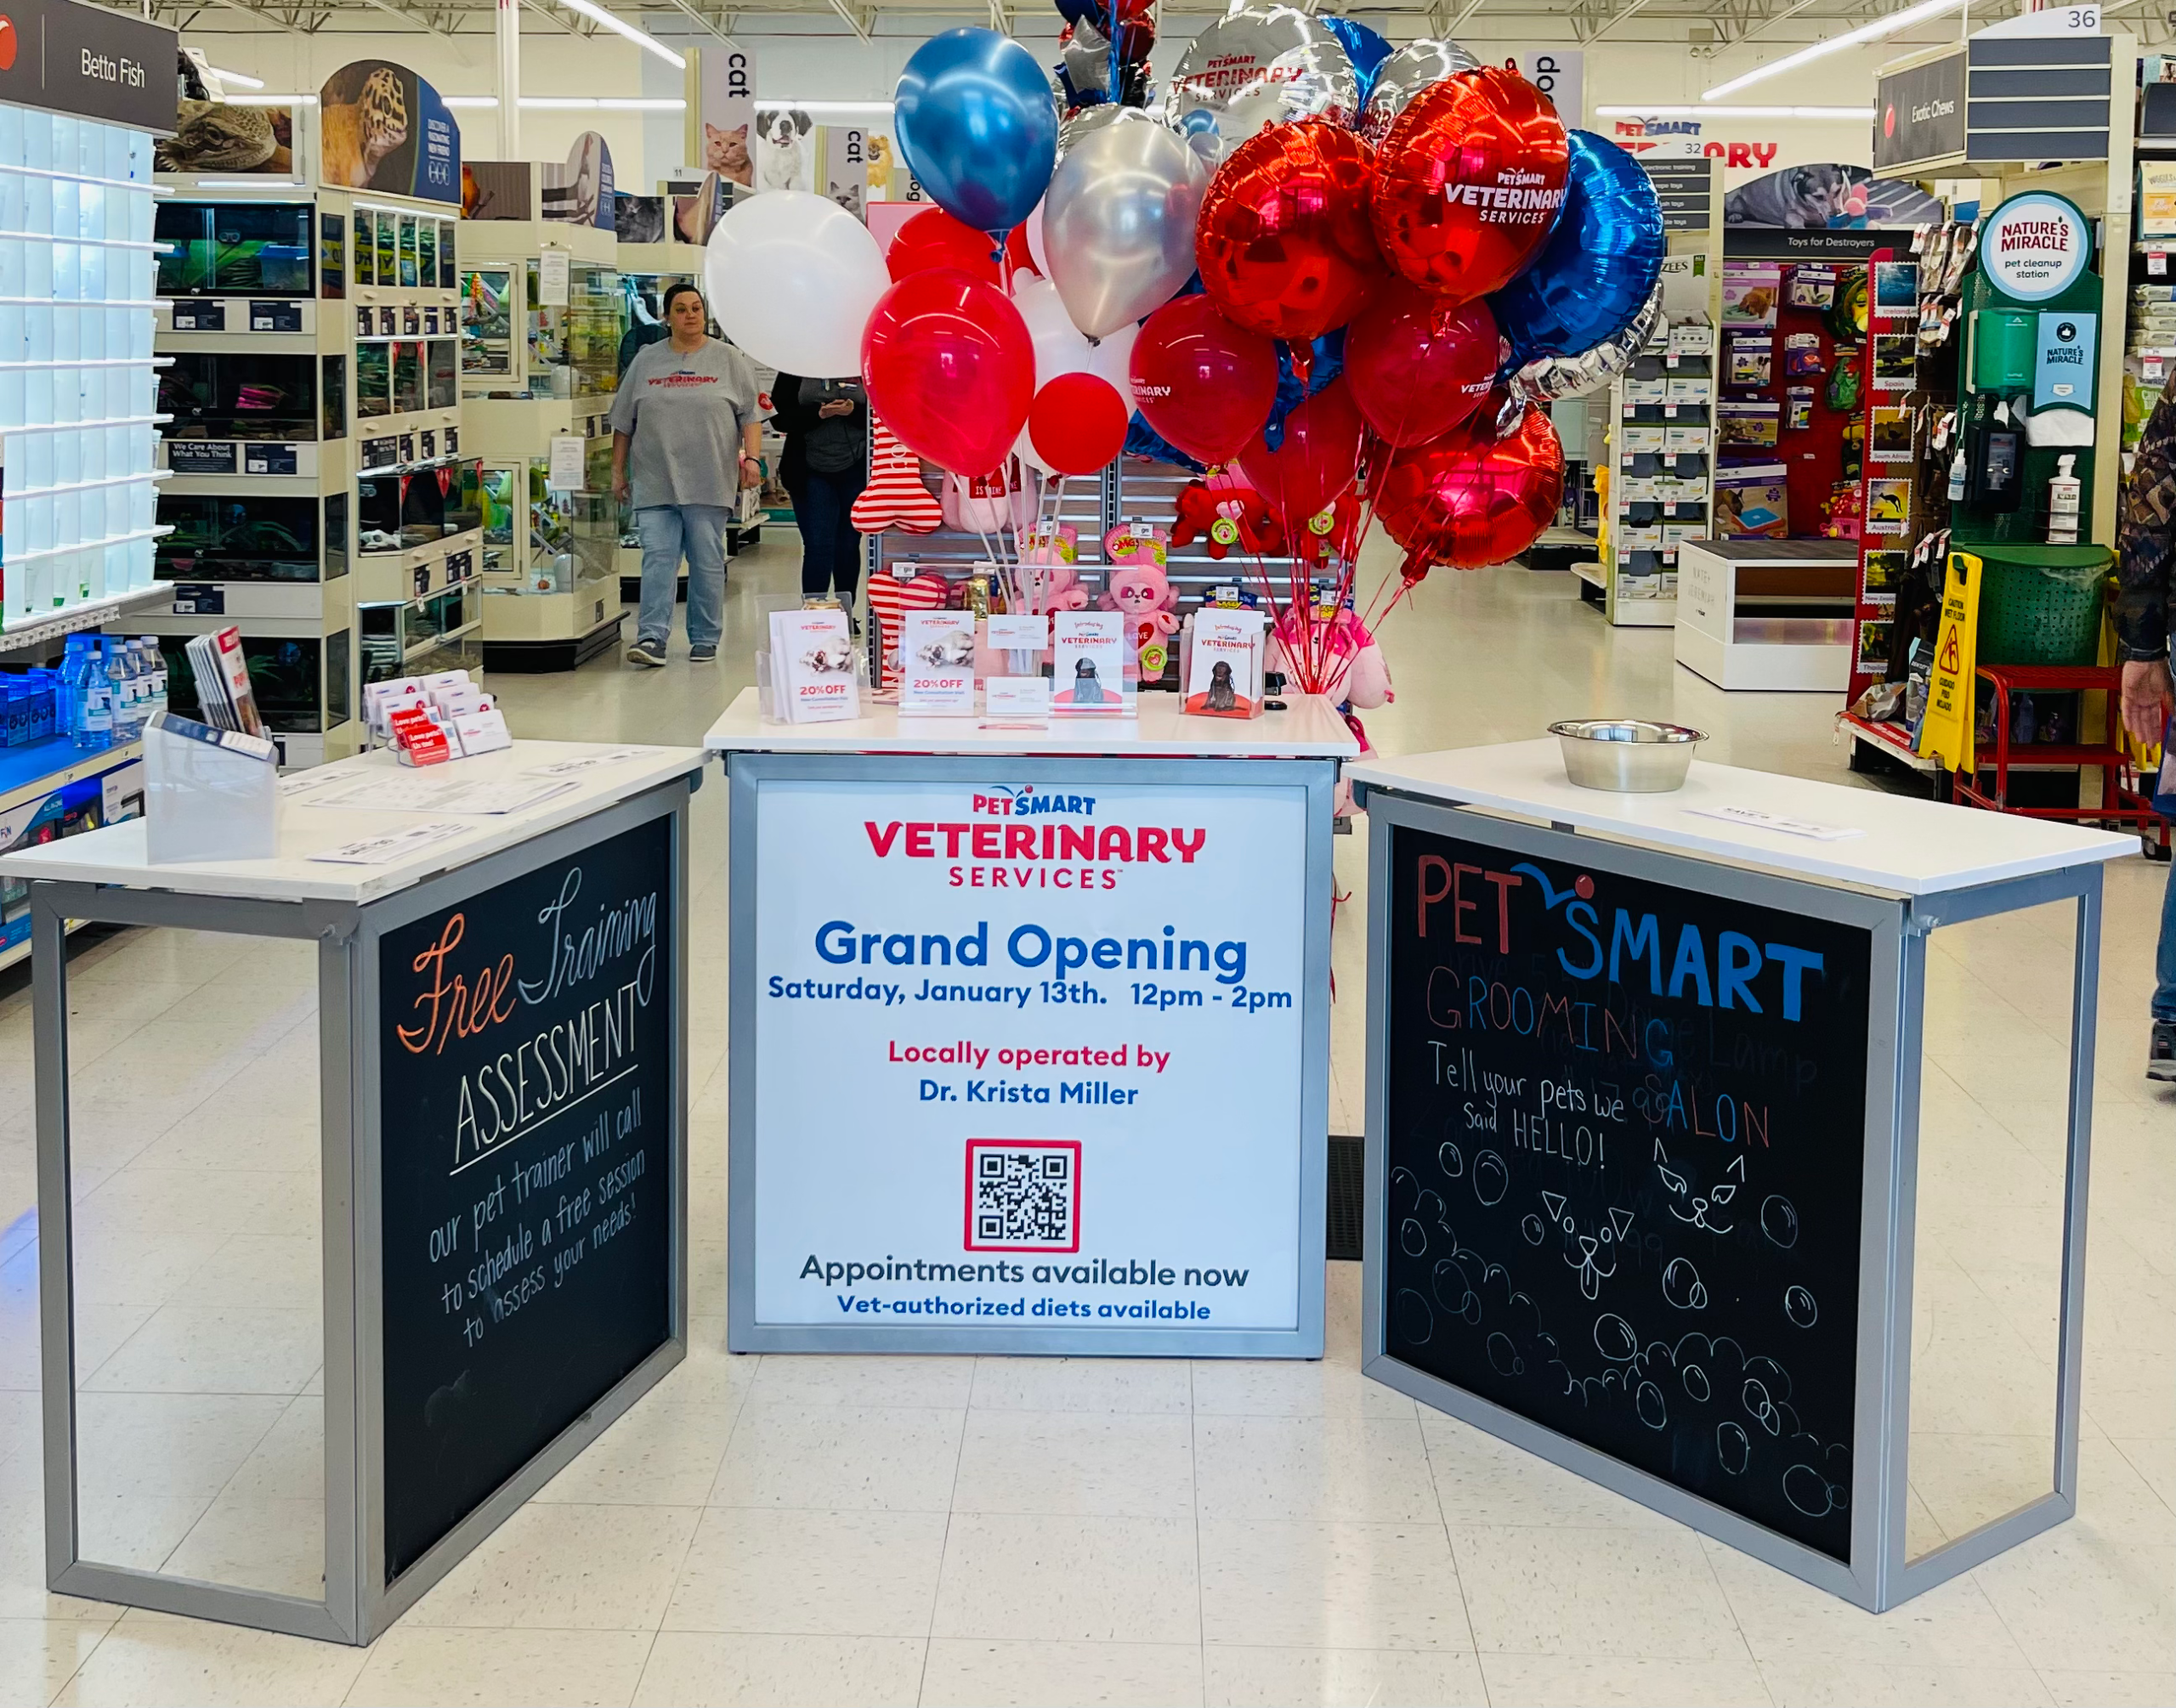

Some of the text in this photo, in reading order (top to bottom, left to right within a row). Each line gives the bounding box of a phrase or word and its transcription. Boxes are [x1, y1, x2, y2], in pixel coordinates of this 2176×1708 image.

[2068, 10, 2096, 28] 36
[82, 48, 145, 88] Betta Fish
[1207, 54, 1256, 69] PETSMART
[728, 53, 750, 99] cat
[1537, 56, 1561, 104] do
[1912, 99, 1954, 122] Exotic Chews
[1615, 120, 1702, 136] PETSMART
[847, 131, 863, 164] cat
[1684, 143, 1702, 154] 32
[1498, 172, 1545, 185] PETSMART
[1444, 183, 1568, 210] VETERINARY
[1479, 210, 1545, 223] SERVICES
[2002, 218, 2069, 237] NATURE'S
[1788, 237, 1875, 248] Toys for Destroyers
[2001, 236, 2069, 252] MIRACLE
[2004, 259, 2062, 274] pet cleanup
[2016, 270, 2049, 279] station
[2046, 354, 2083, 365] MIRACLE
[2047, 347, 2083, 358] NATURE'S
[1127, 631, 1148, 640] LOVE
[1201, 639, 1255, 649] VETERINARY
[799, 685, 847, 695] 20% OFF
[913, 679, 963, 688] 20% OFF
[395, 717, 410, 727] Love
[410, 733, 424, 742] Love
[973, 791, 1096, 817] PETSMART
[864, 822, 1206, 863] VETERINARY
[949, 867, 1118, 890] SERVICES
[518, 867, 657, 1007] Training
[1417, 855, 1523, 954] PET
[1557, 901, 1824, 1021] SMART
[814, 920, 1247, 983] Grand Opening
[397, 913, 517, 1055] Free
[768, 976, 906, 1007] Saturday,
[915, 979, 1031, 1010] January
[1040, 980, 1108, 1004] 13th.
[1130, 982, 1203, 1012] 12pm
[1231, 985, 1293, 1013] 2pm
[1427, 965, 1674, 1066] GROOMING
[889, 1041, 1171, 1073] Locally operated by
[454, 980, 638, 1165] ASSESSMENT
[1428, 1041, 1624, 1123] Tell your pets we
[920, 1079, 1139, 1106] Dr. Krista Miller
[1642, 1073, 1770, 1148] SALON
[1464, 1101, 1606, 1170] Said HELLO!
[429, 1087, 642, 1263] our pet trainer will call
[441, 1149, 645, 1315] to schedule a free session
[463, 1191, 638, 1349] to assess your needs!
[800, 1254, 1250, 1287] Appointments available now
[837, 1294, 1211, 1321] Vet-authorized diets available
